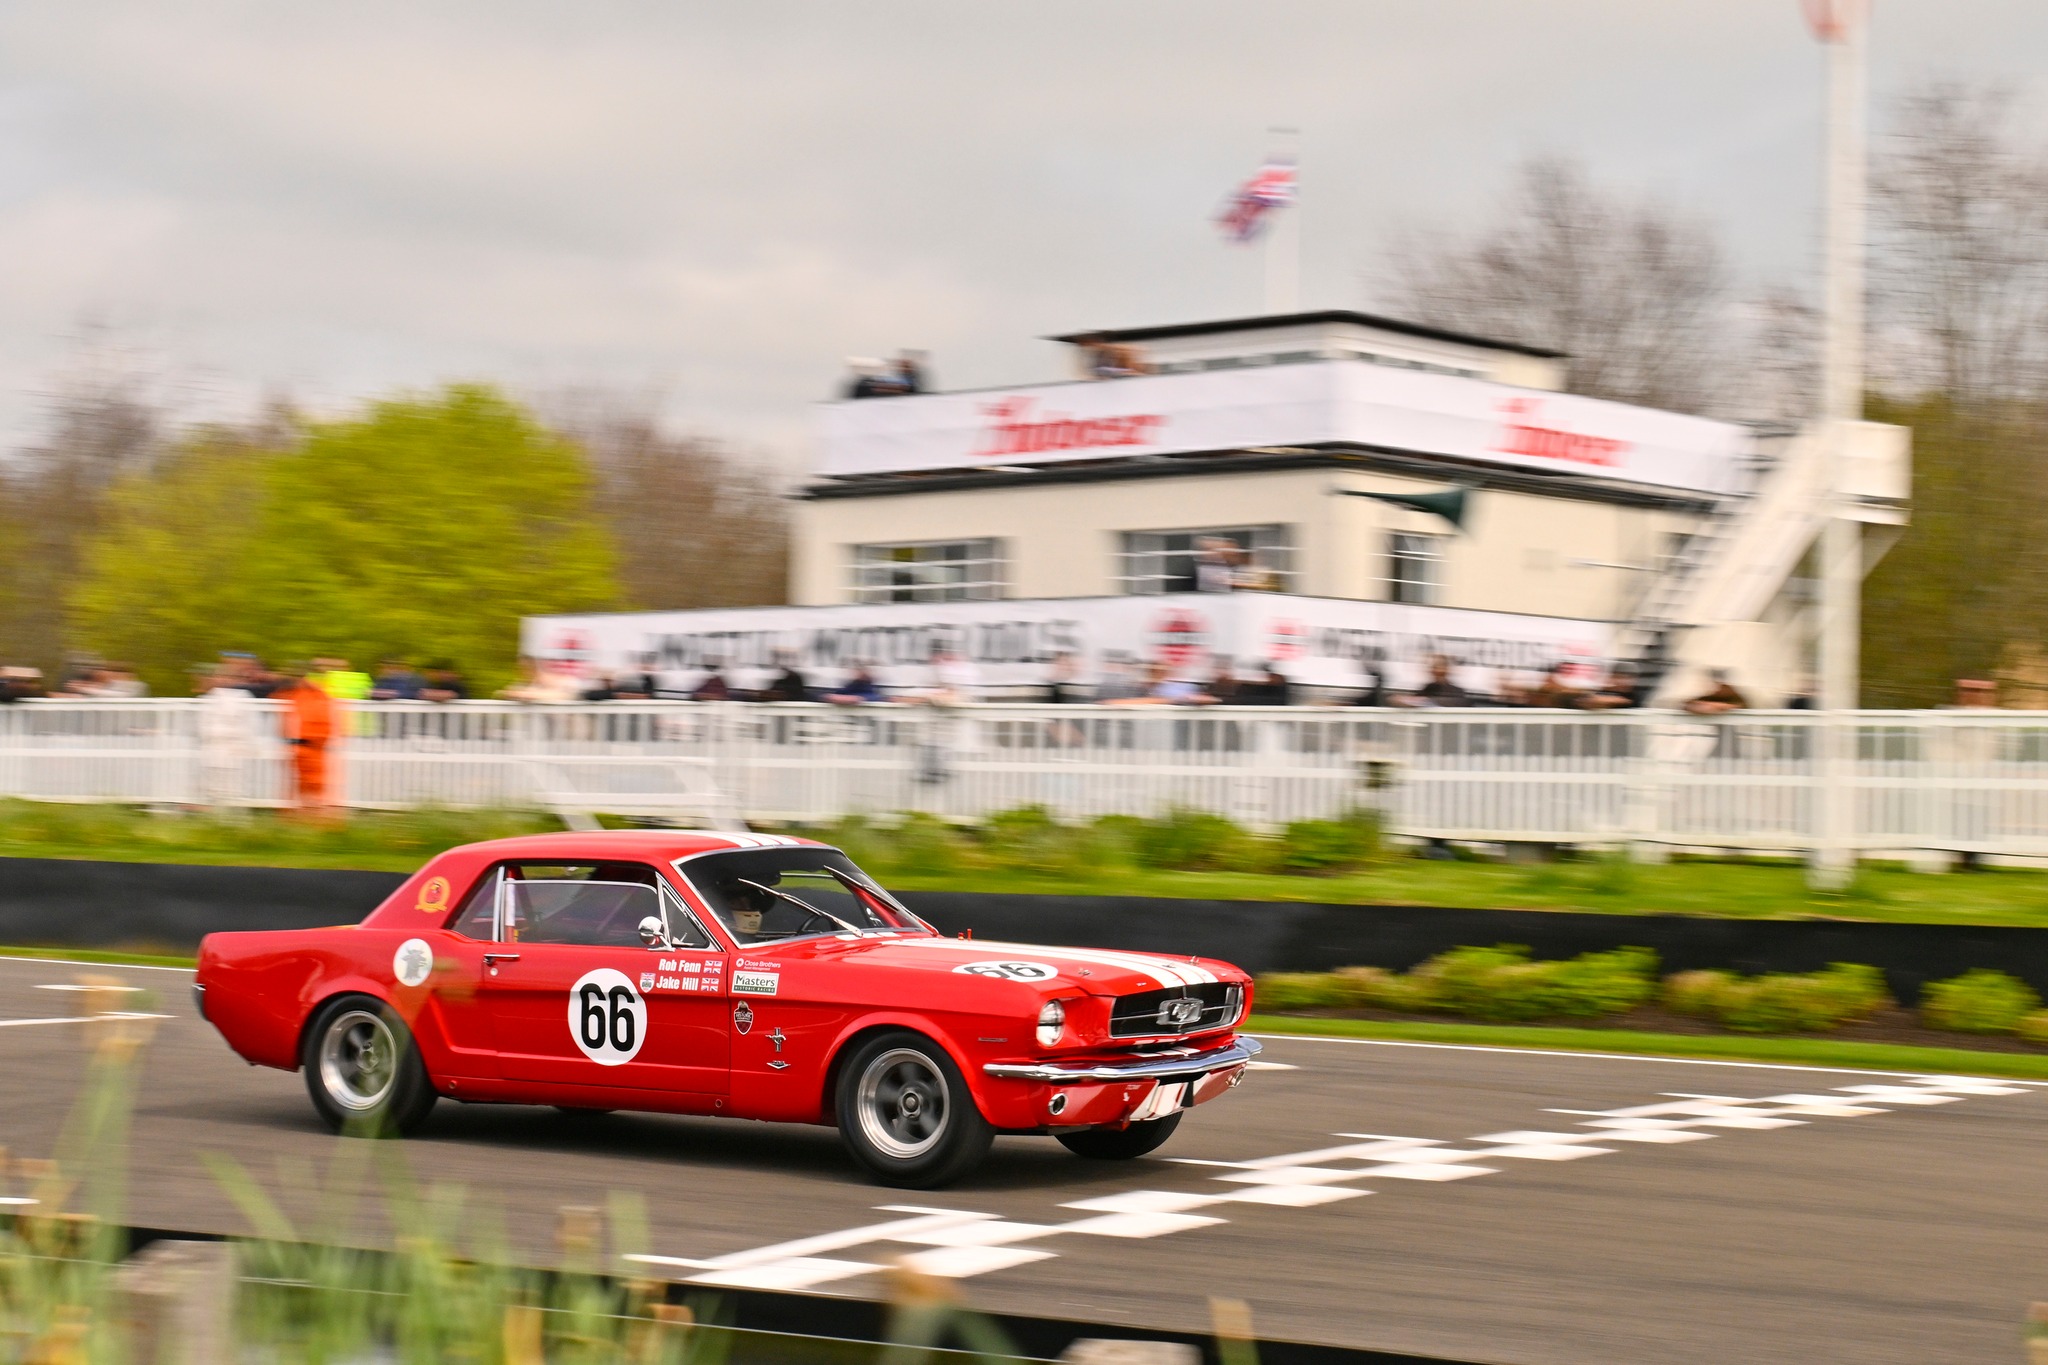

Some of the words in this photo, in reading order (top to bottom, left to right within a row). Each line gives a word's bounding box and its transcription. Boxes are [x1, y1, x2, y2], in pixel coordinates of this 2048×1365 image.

[659, 959, 677, 971] Rob
[678, 960, 701, 973] Fenn
[759, 961, 781, 969] Brothers
[963, 962, 1047, 979] 66
[656, 976, 680, 989] Jake
[682, 977, 699, 991] Hill
[736, 975, 775, 987] Masters
[580, 983, 635, 1052] 66
